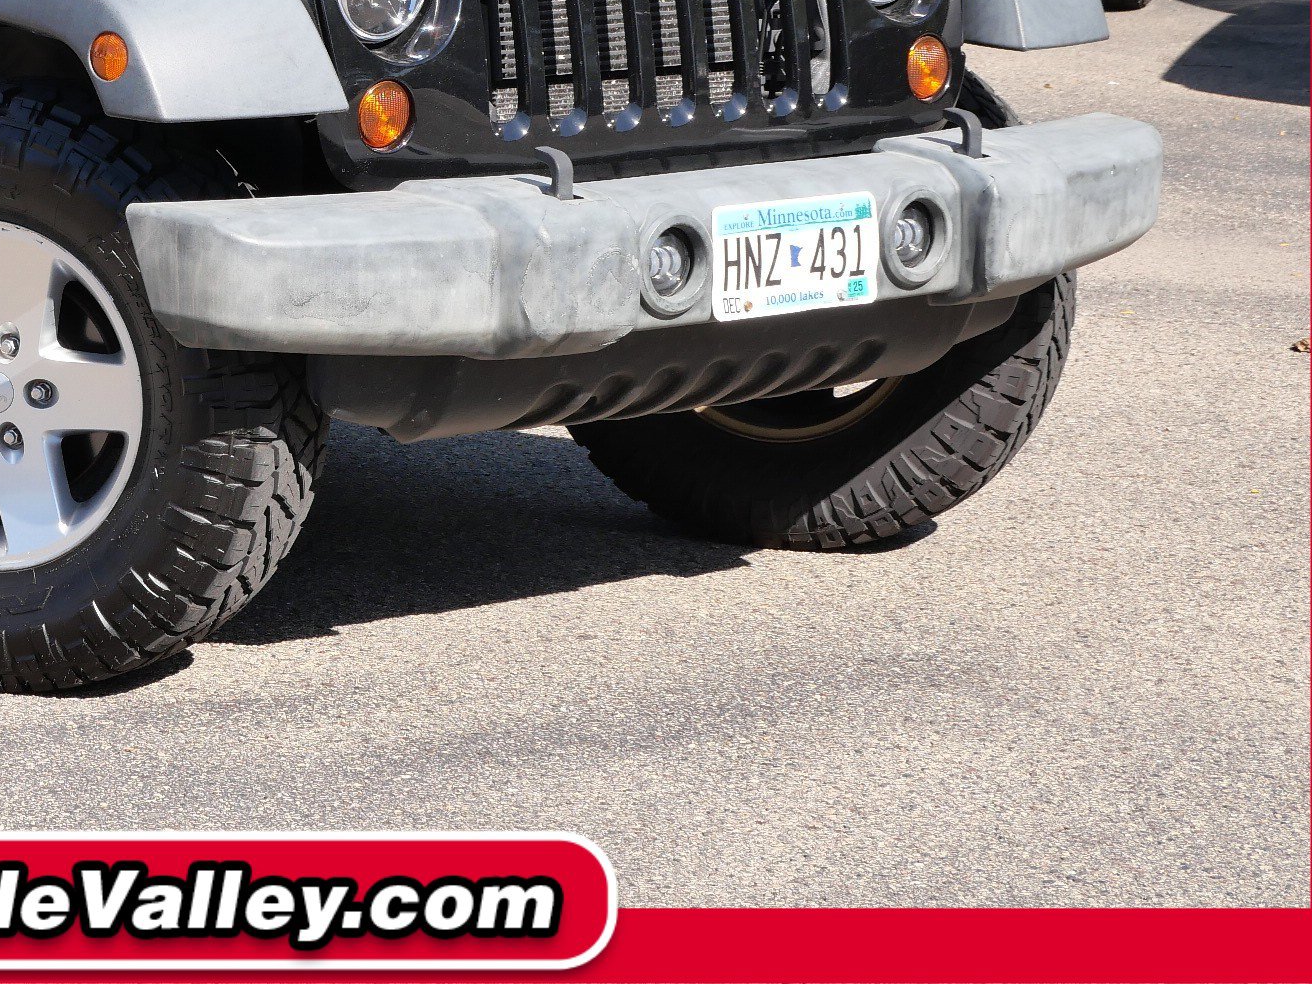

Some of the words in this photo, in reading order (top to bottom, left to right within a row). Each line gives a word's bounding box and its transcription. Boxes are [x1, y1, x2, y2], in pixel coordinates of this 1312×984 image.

[724, 221, 755, 231] EXPLORE
[757, 206, 854, 227] Minnesota.com
[724, 232, 782, 292] HNZ
[810, 224, 866, 281] 431
[853, 280, 864, 292] 25
[723, 297, 741, 314] DEC
[766, 292, 797, 307] 10,000
[799, 289, 825, 303] lakes
